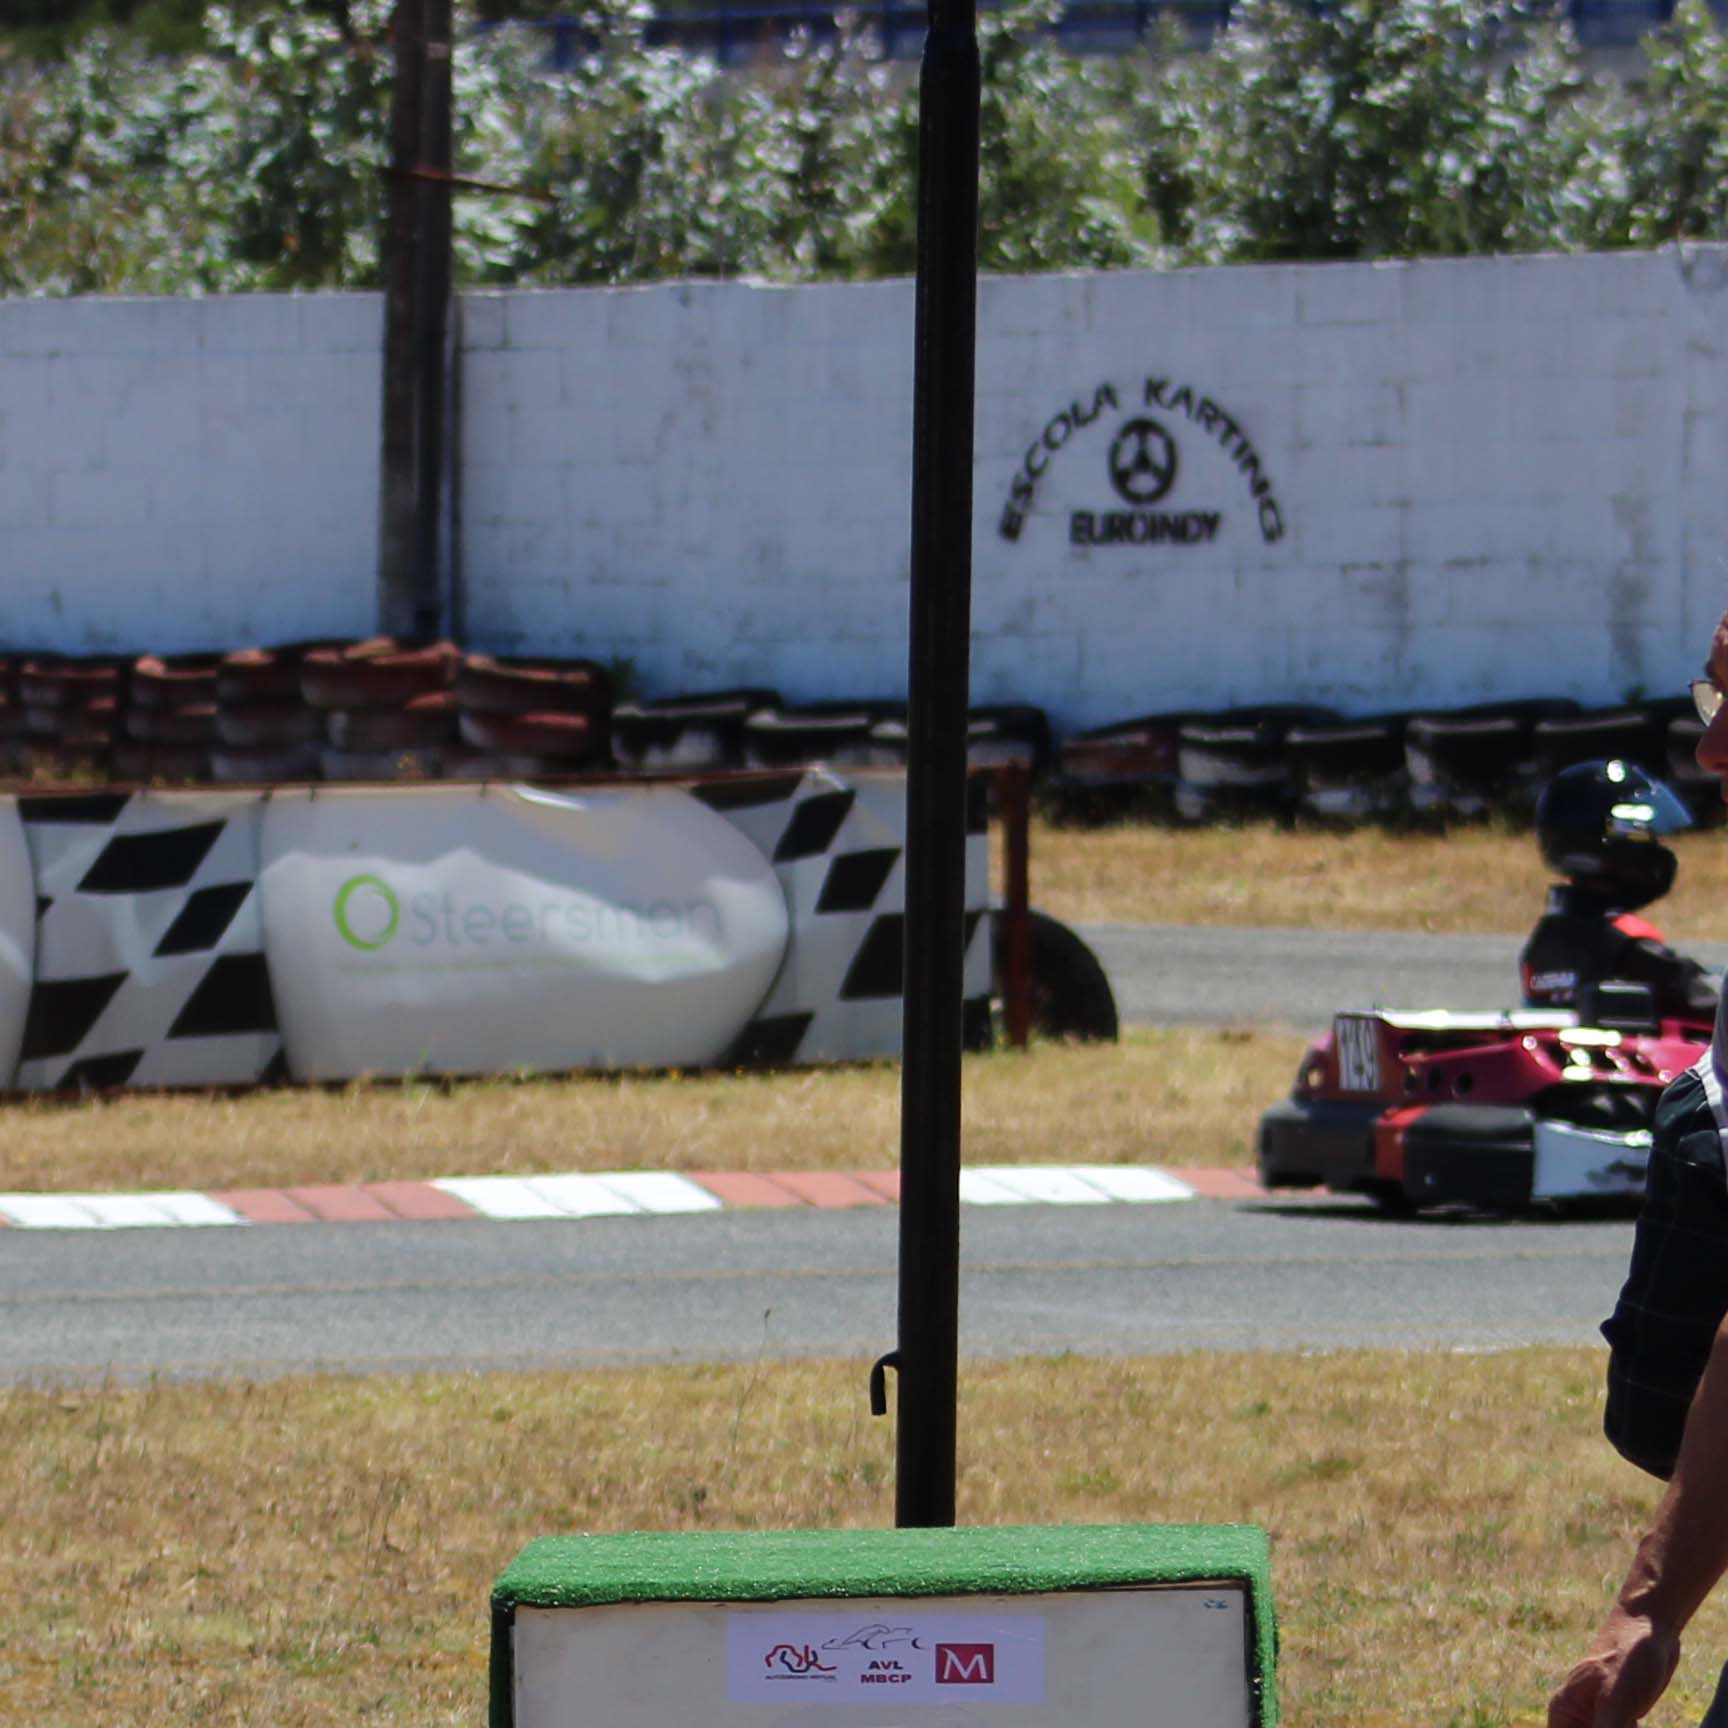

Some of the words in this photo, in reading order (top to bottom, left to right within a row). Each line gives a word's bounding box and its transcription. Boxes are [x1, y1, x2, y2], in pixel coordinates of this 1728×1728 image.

[998, 382, 1118, 543] ESCOLA
[1143, 376, 1284, 545] KARTING
[1069, 510, 1221, 546] EUROINDY
[410, 890, 724, 947] Steersman
[859, 1673, 913, 1684] MBCP
[867, 1660, 905, 1671] AVL
